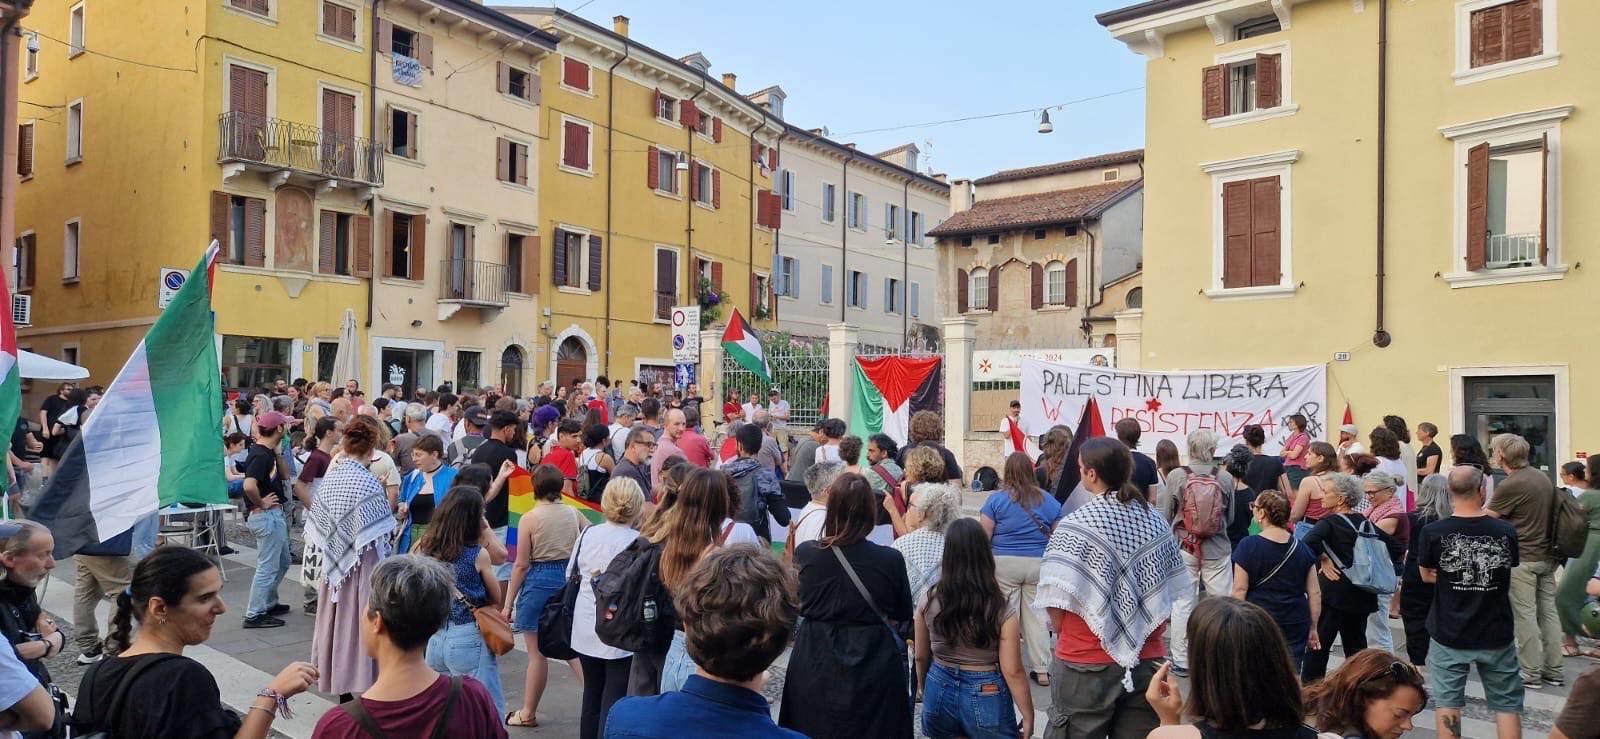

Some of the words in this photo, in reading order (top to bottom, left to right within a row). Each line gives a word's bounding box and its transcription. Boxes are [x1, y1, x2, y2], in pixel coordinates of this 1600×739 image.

[1042, 370, 1173, 398] PALESTINA
[1182, 374, 1288, 400] LIBERA
[1041, 397, 1062, 421] W
